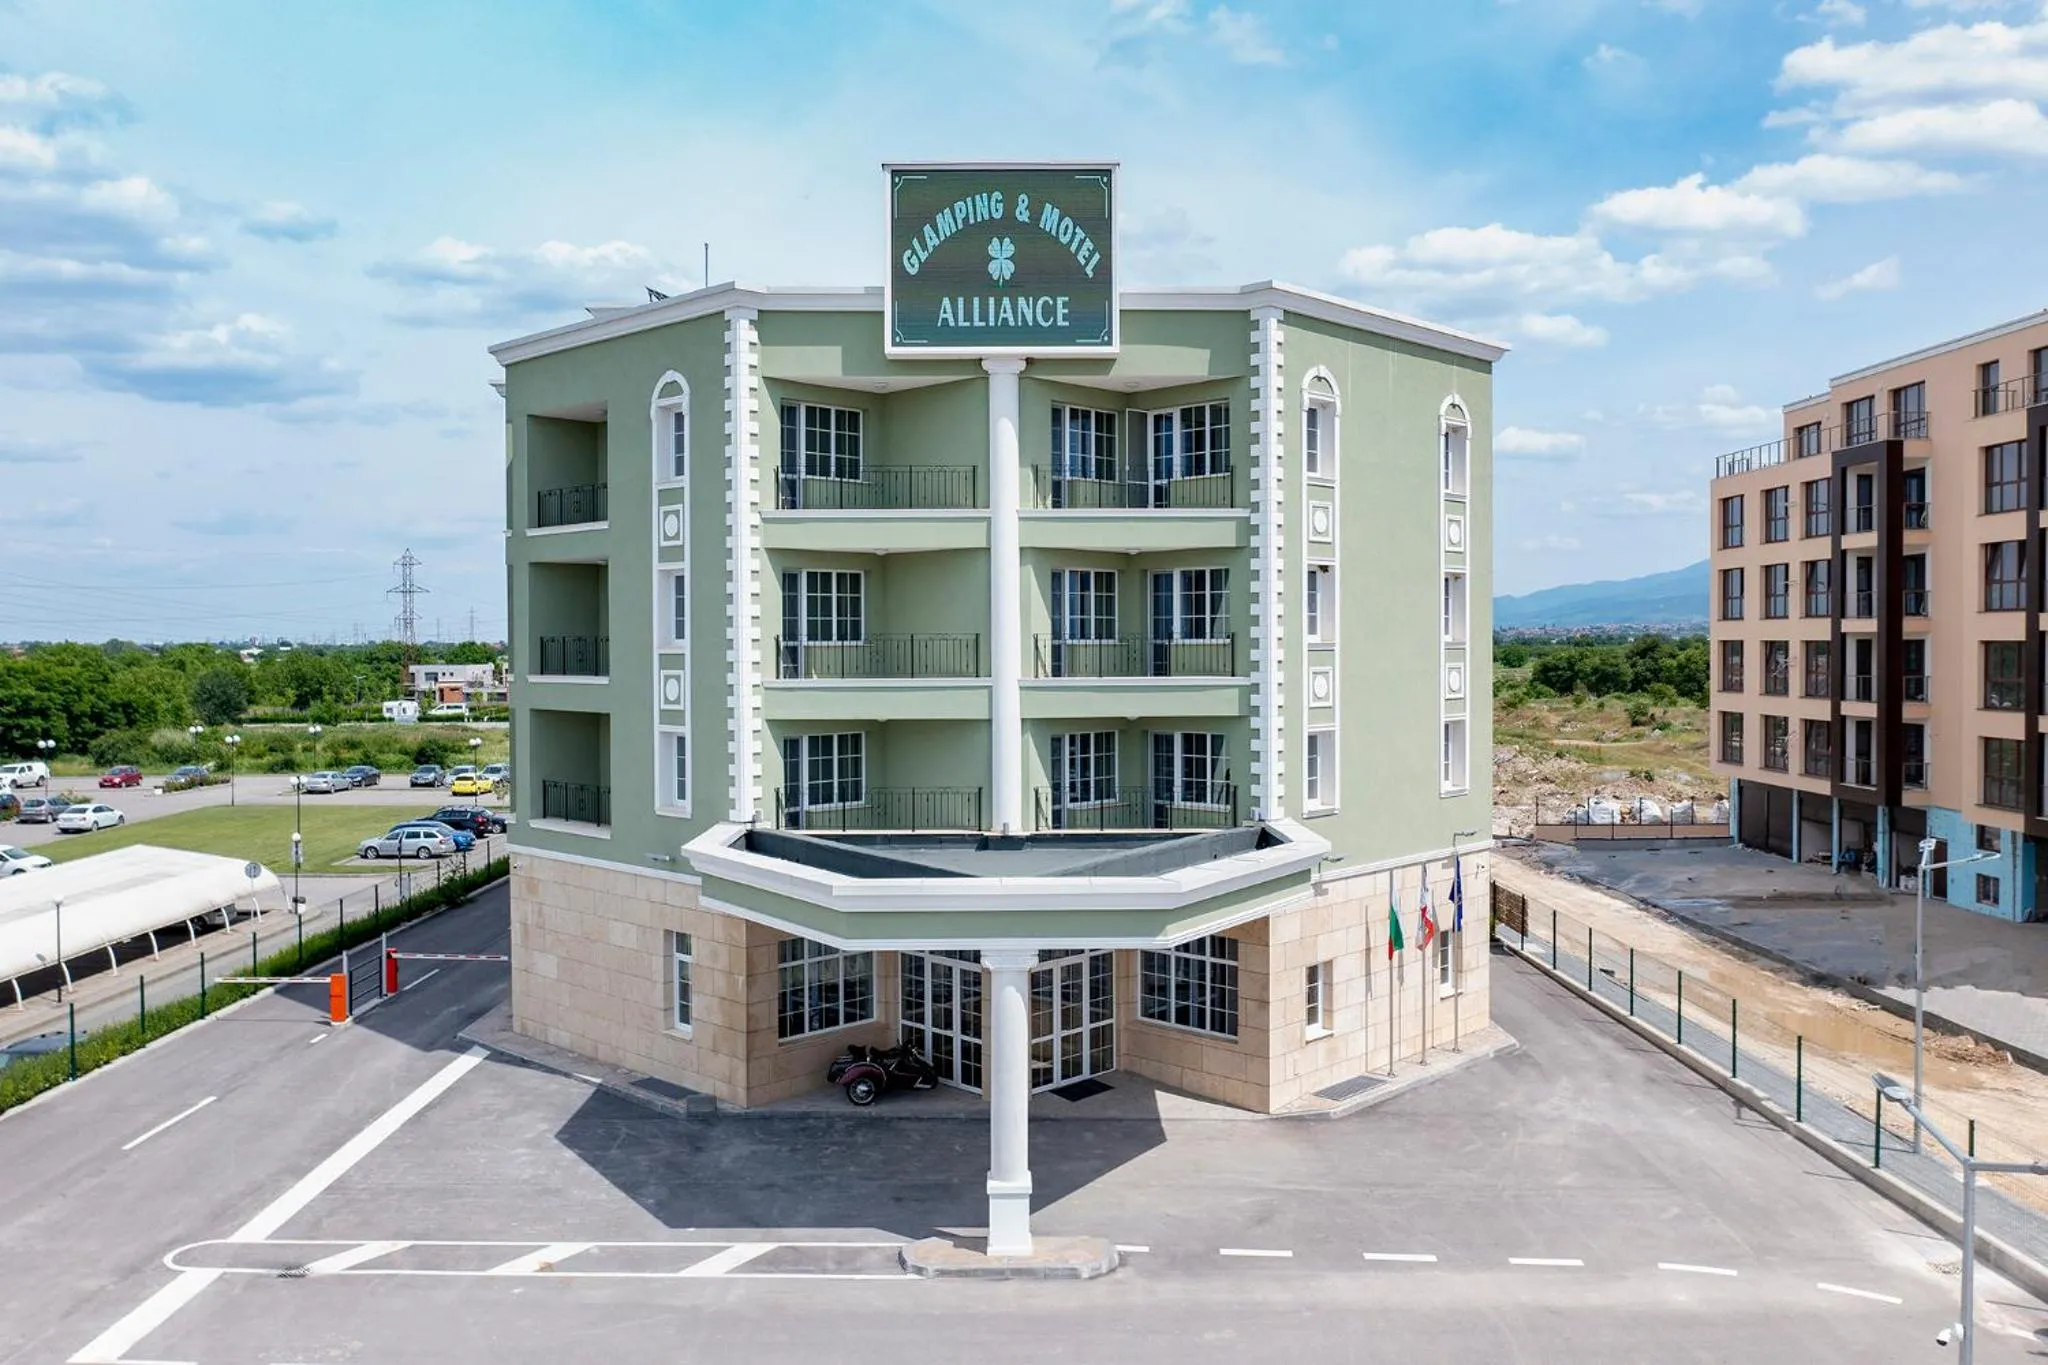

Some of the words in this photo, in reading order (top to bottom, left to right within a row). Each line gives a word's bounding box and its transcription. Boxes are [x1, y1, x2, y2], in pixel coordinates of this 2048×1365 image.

[903, 191, 1004, 275] GLAMPING
[1015, 193, 1030, 223] &
[1039, 203, 1100, 278] MOTEL
[937, 296, 1069, 327] ALLIANCE
